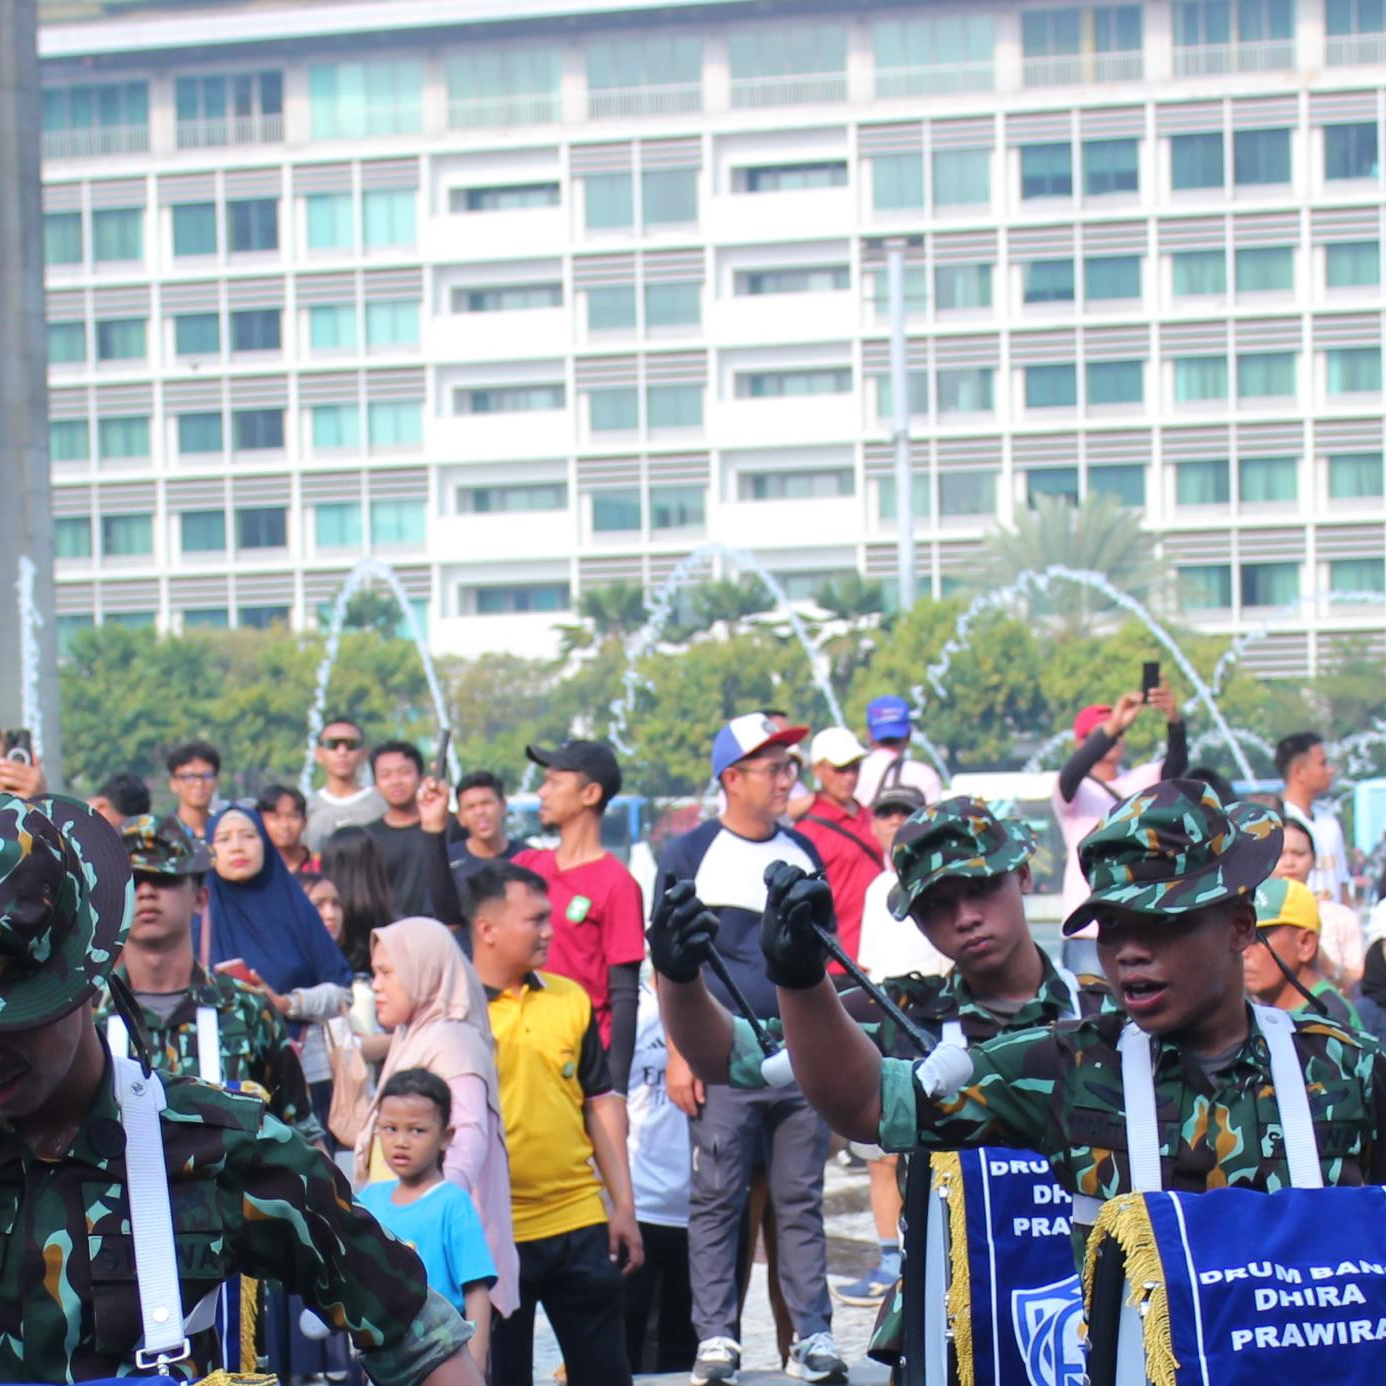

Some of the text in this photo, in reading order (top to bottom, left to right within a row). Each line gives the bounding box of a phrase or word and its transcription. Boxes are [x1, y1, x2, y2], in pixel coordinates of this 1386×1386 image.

[1013, 1216, 1073, 1238] PRA
[1199, 1261, 1303, 1286] DRUM
[1254, 1283, 1367, 1312] DHIRA
